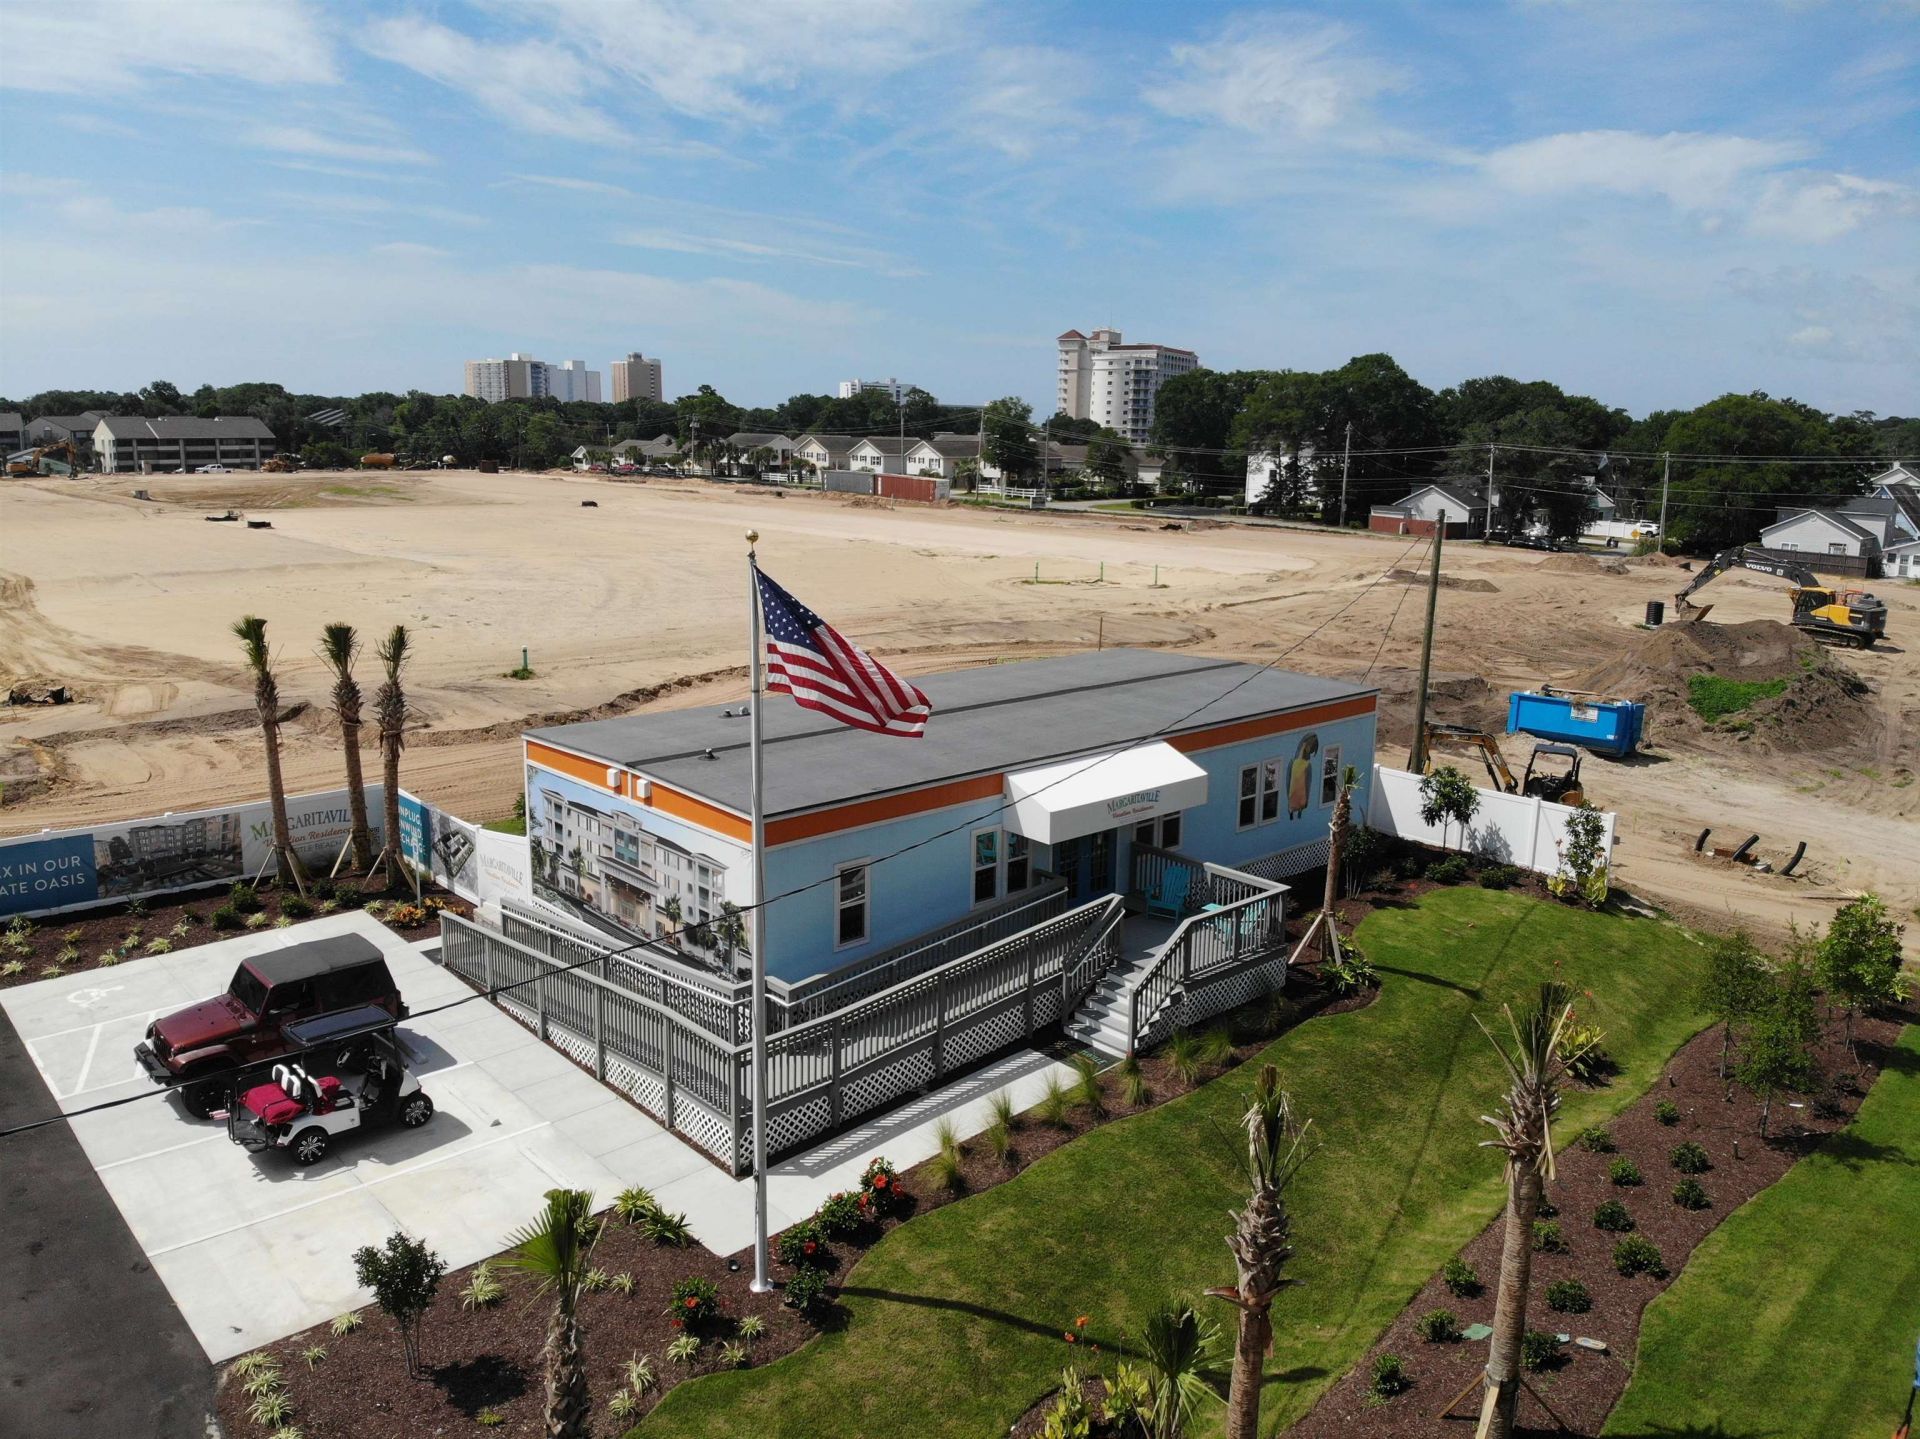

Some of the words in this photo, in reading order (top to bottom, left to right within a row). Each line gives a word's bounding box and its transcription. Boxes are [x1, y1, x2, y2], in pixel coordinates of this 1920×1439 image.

[1745, 562, 1772, 572] VOLVO
[19, 862, 37, 876] IN
[43, 855, 81, 872] OUR
[34, 872, 85, 891] OASIS
